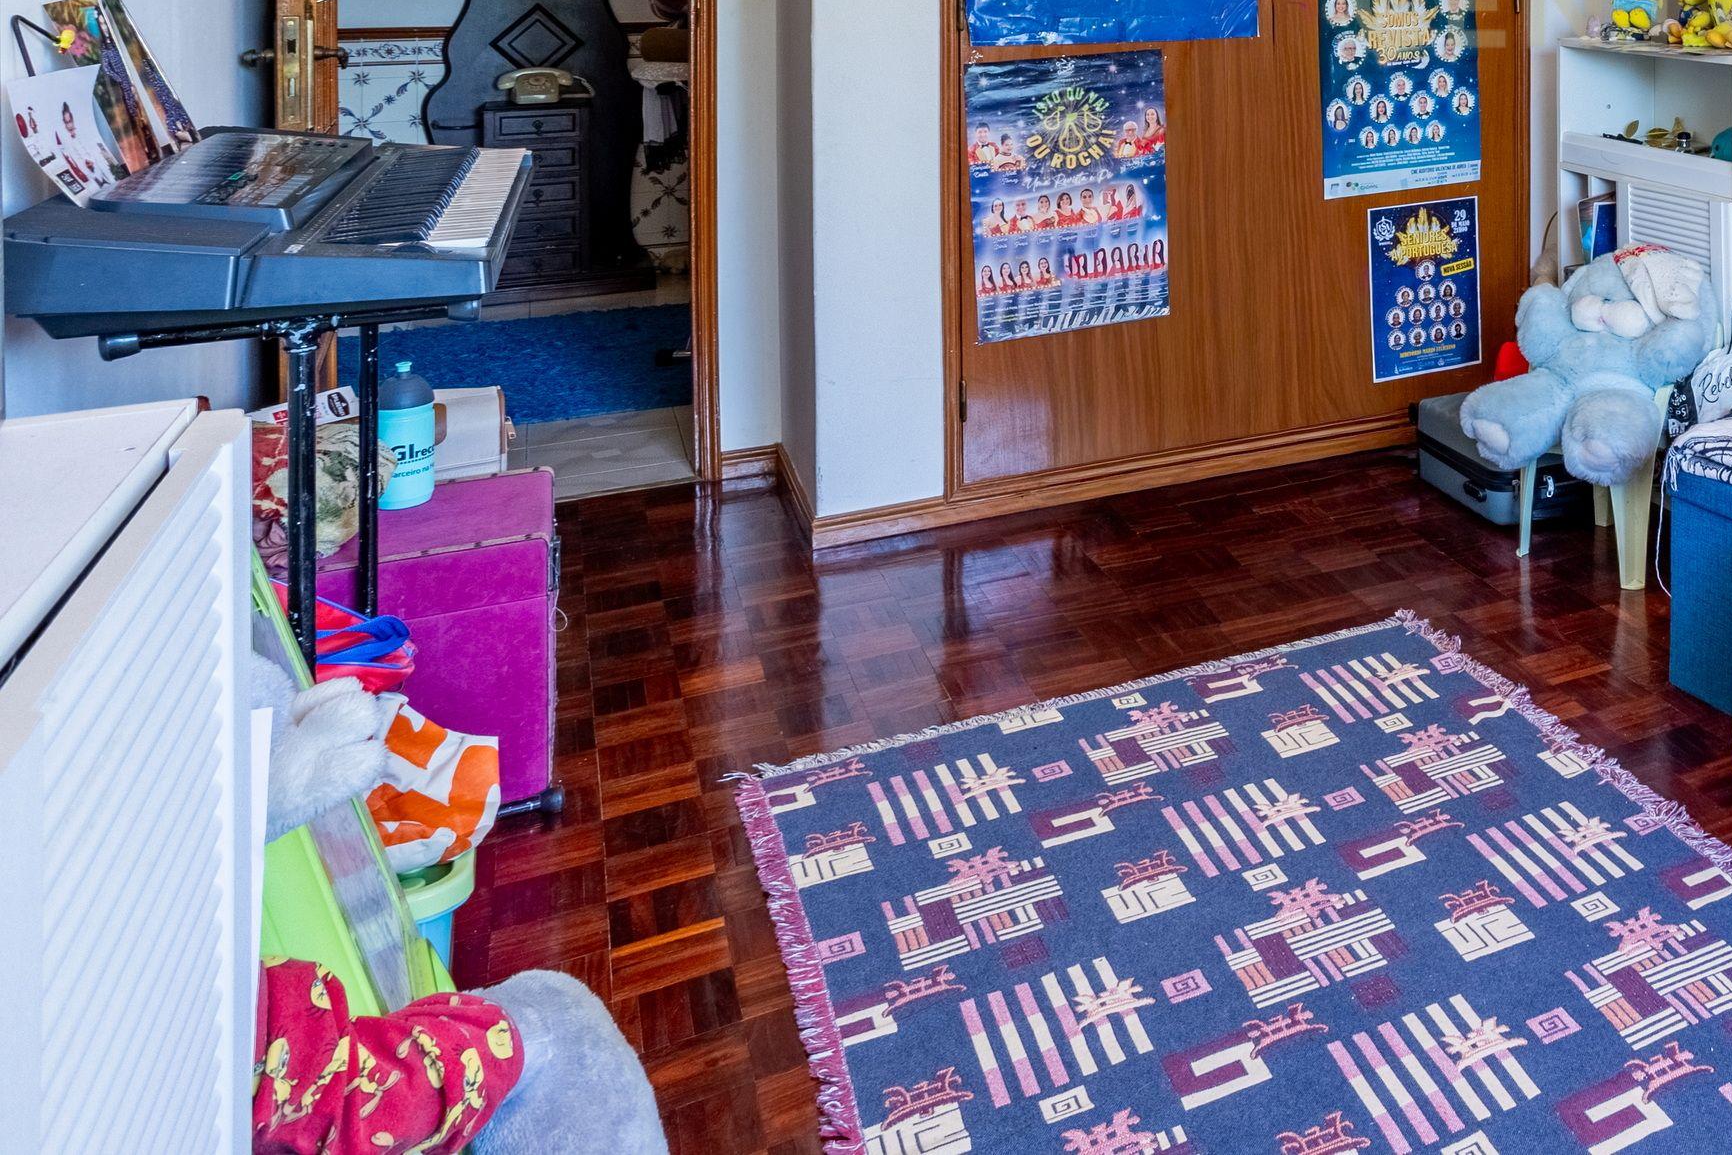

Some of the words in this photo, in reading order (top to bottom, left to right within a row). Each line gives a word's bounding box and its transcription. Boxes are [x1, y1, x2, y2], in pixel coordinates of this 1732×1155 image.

[1381, 12, 1419, 28] SOMOS
[1367, 28, 1431, 50] REVISTA
[1376, 45, 1397, 65] 30
[1396, 50, 1421, 62] ANOS
[1032, 89, 1061, 119] ISTO
[1066, 87, 1085, 102] OU
[1088, 91, 1110, 113] VAI
[1026, 134, 1051, 160] OU
[1454, 208, 1467, 221] 29
[1401, 230, 1447, 245] SENIORES
[1400, 241, 1458, 260] PORTUGUESA
[391, 468, 421, 478] arceiro
